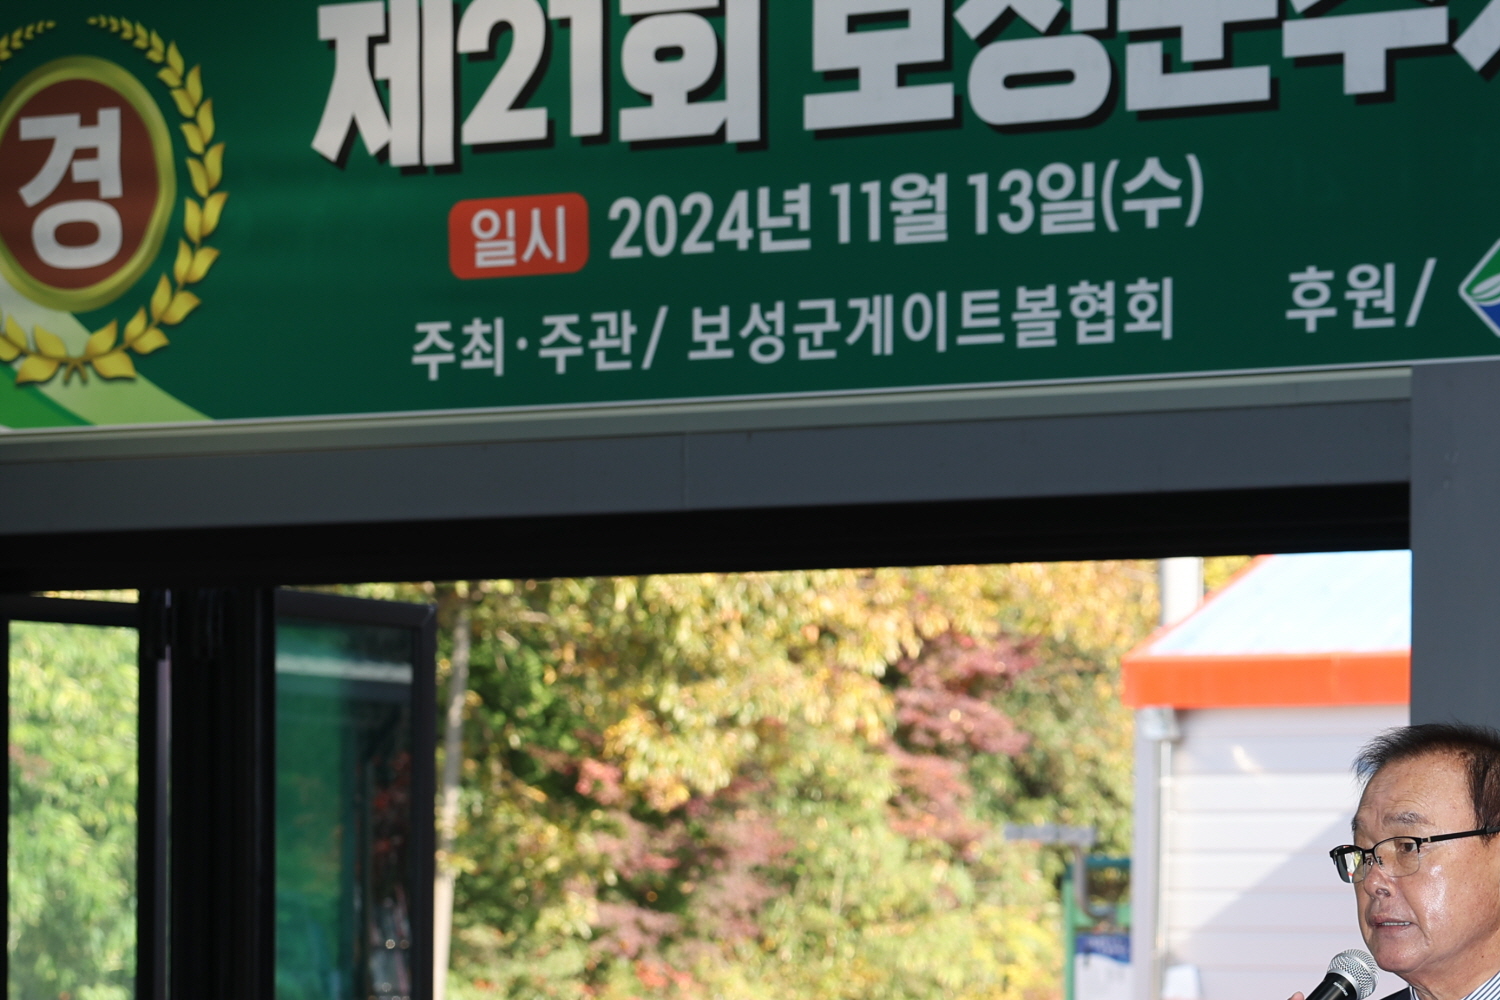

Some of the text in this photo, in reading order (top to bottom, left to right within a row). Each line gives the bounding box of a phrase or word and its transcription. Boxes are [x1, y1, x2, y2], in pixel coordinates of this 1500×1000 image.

[311, 0, 762, 167] 제21회
[18, 106, 124, 270] 경
[608, 153, 1205, 260] 2024년 11월 13일(수)
[470, 205, 568, 269] 일시
[689, 278, 1173, 363] 보성군게이트볼협회
[1285, 257, 1438, 333] 후원/
